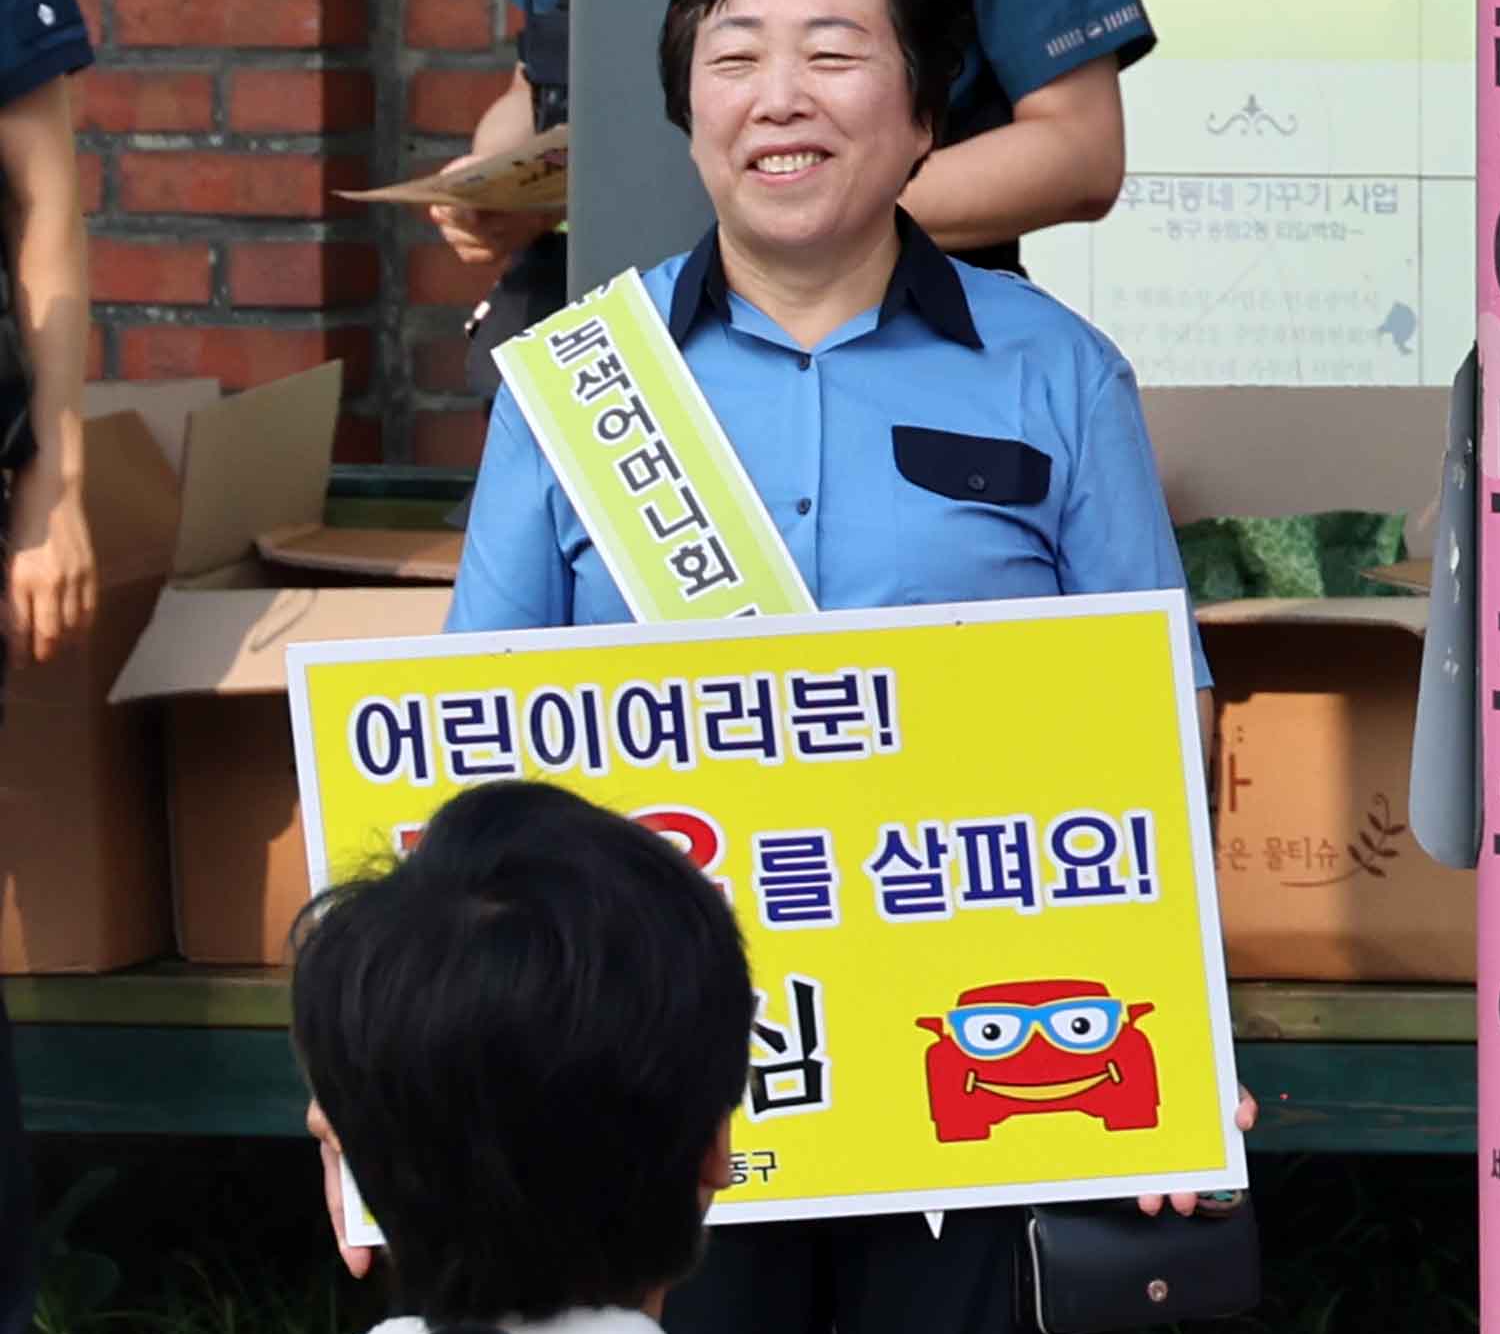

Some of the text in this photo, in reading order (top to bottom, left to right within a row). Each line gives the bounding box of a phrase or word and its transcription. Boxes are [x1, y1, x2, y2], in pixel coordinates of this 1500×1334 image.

[1342, 182, 1399, 215] 사업
[550, 320, 739, 595] 녹색어머니회
[354, 669, 894, 781] 어린이여러분!
[872, 817, 1153, 921] 살펴요!
